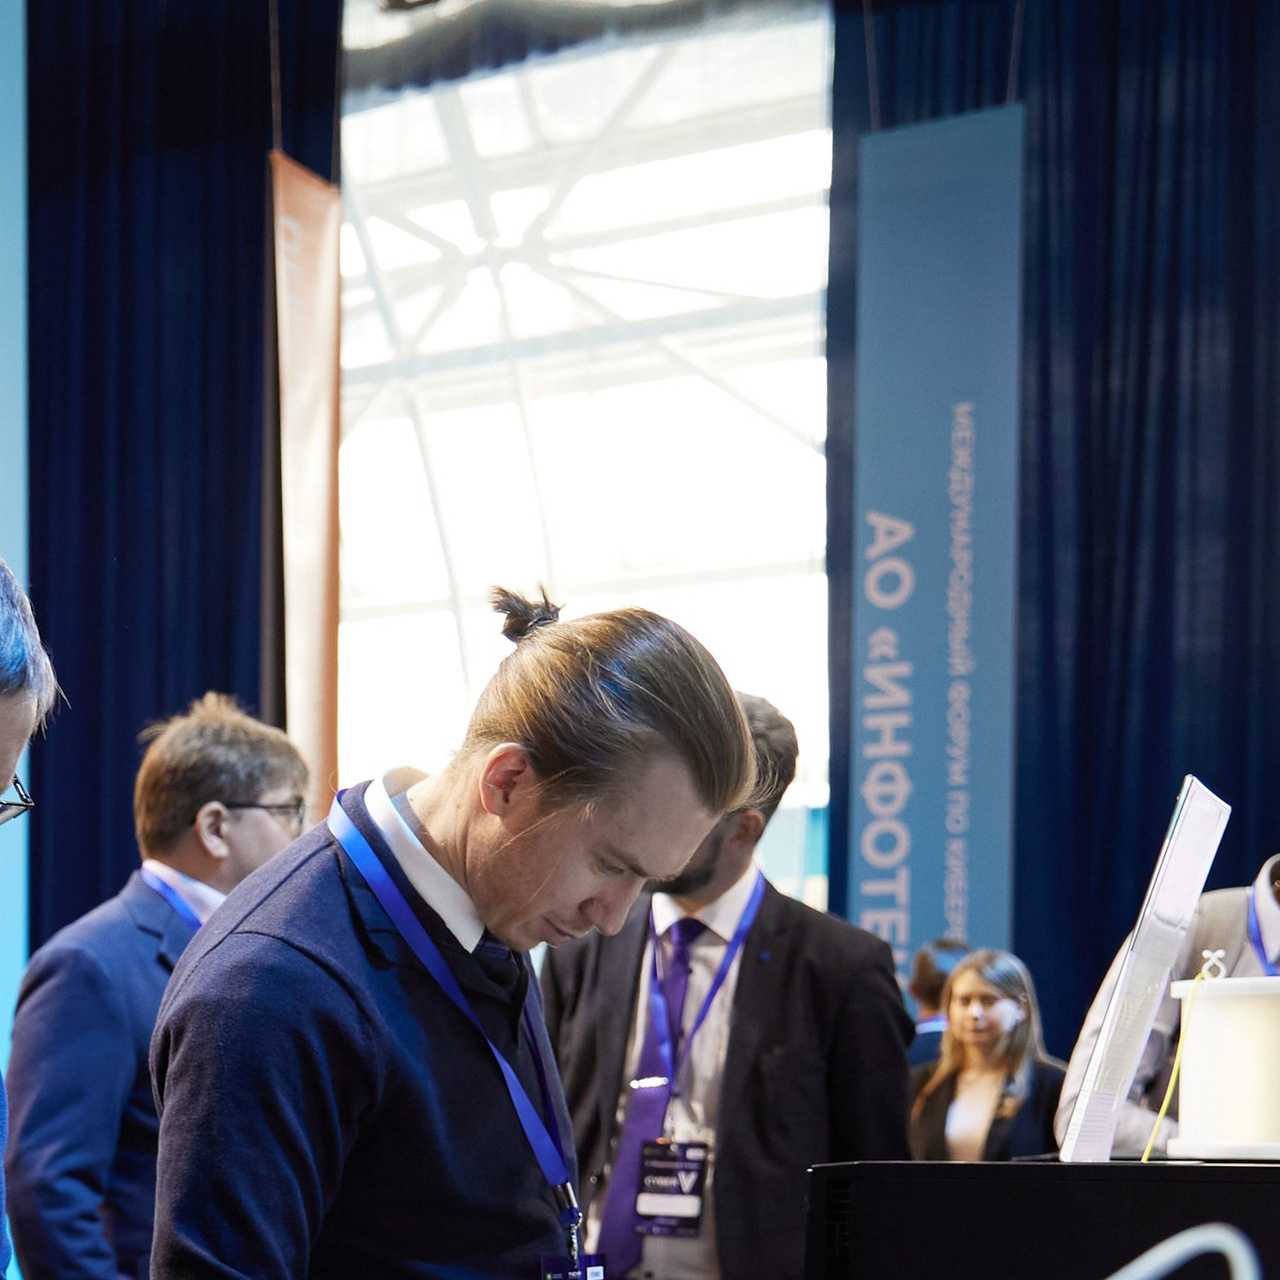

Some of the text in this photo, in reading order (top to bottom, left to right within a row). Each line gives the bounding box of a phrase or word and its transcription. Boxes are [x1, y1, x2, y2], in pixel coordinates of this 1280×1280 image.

[947, 402, 976, 676] МЕЖДУНАРОДНЫЙ
[860, 511, 915, 990] АО «ИНФОТЕ
[945, 680, 971, 785] ФОРУМ
[945, 790, 970, 833] ПО
